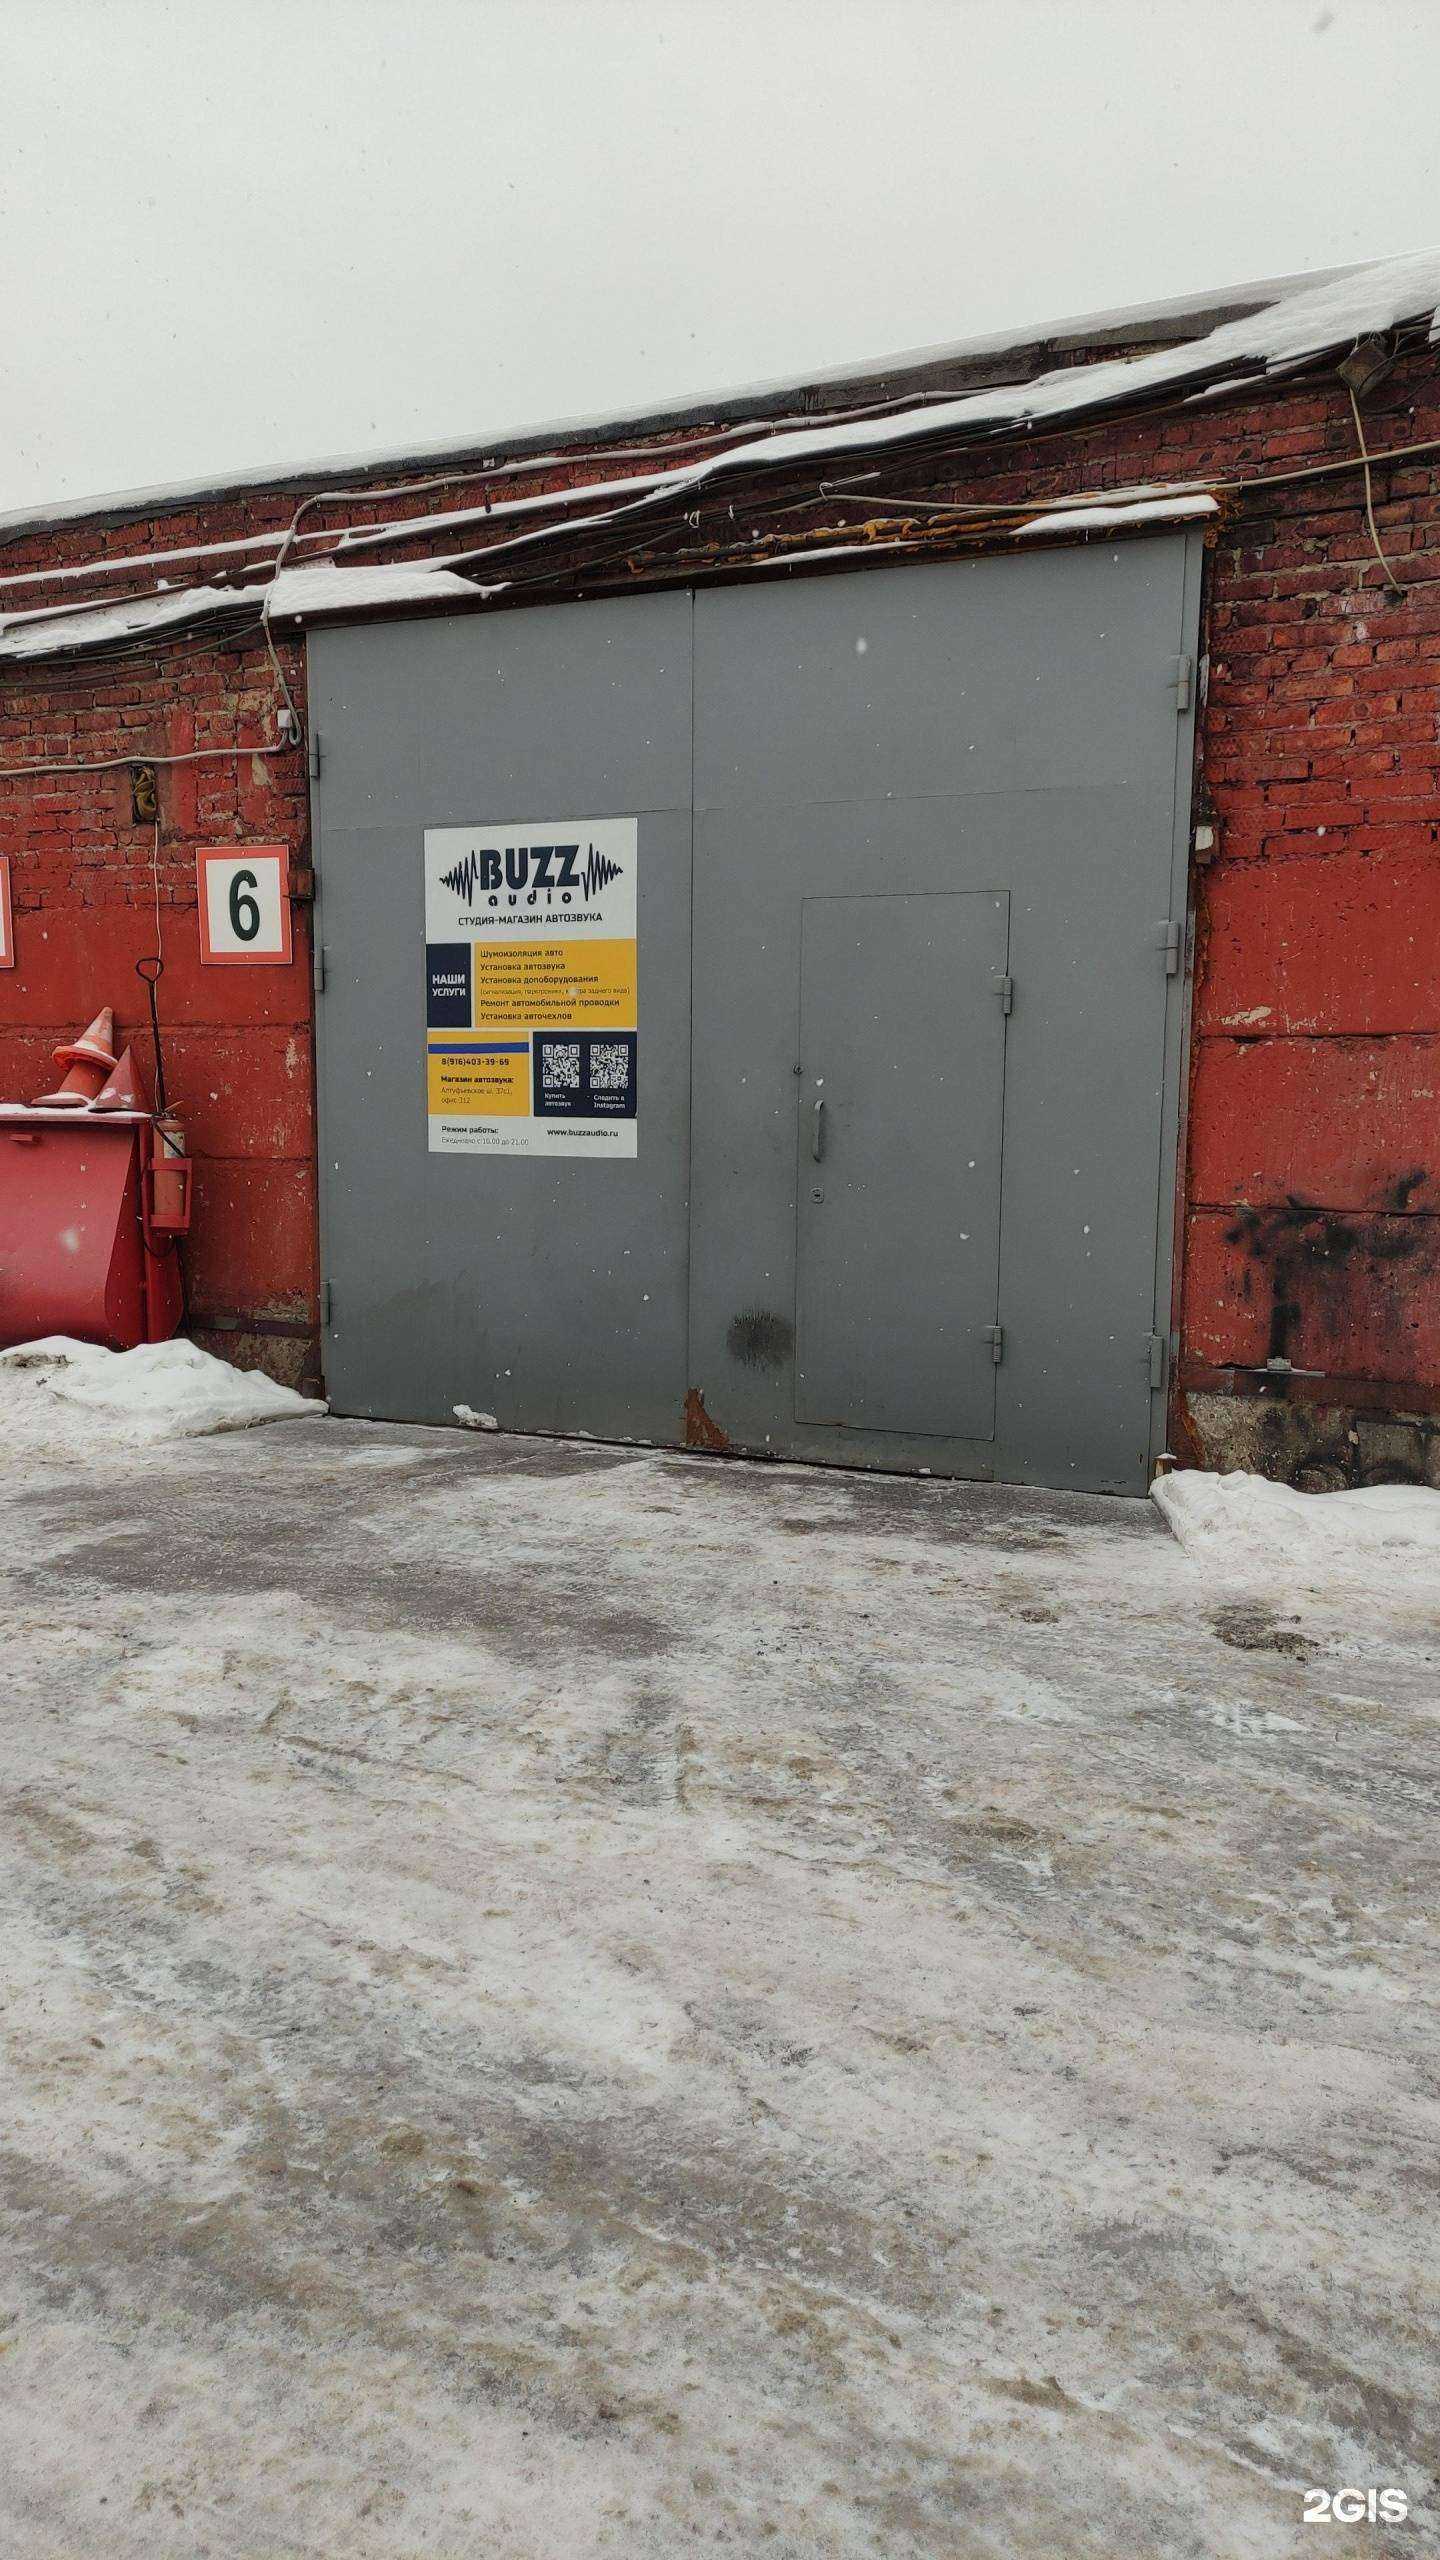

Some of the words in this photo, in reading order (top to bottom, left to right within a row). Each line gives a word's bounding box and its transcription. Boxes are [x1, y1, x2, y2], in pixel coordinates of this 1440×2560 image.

[479, 844, 580, 891] BUZZ
[488, 889, 572, 907] audio
[229, 869, 260, 941] 6
[458, 914, 543, 927] СТУДИЯ-МАГАЗИН
[545, 912, 603, 924] АВТОЗВУКА
[480, 950, 542, 959] Шумоизоляция
[480, 963, 521, 971] Установка
[523, 963, 566, 971] автозвука
[432, 973, 466, 986] НАШИ
[480, 976, 521, 984] Установка
[523, 975, 599, 985] допоборудования
[431, 986, 466, 998] УСЛУГИ
[480, 999, 509, 1007] Ремонт
[511, 998, 576, 1007] автомобильной
[578, 999, 620, 1007] проводки
[480, 1012, 521, 1020] Установка
[523, 1012, 572, 1020] авточехлов
[441, 1075, 473, 1083] Магазин
[544, 1092, 566, 1100] Купить
[593, 1101, 626, 1110] Instagram
[441, 1125, 467, 1133] Режим
[546, 1128, 619, 1137] www.buzzaudio.ru
